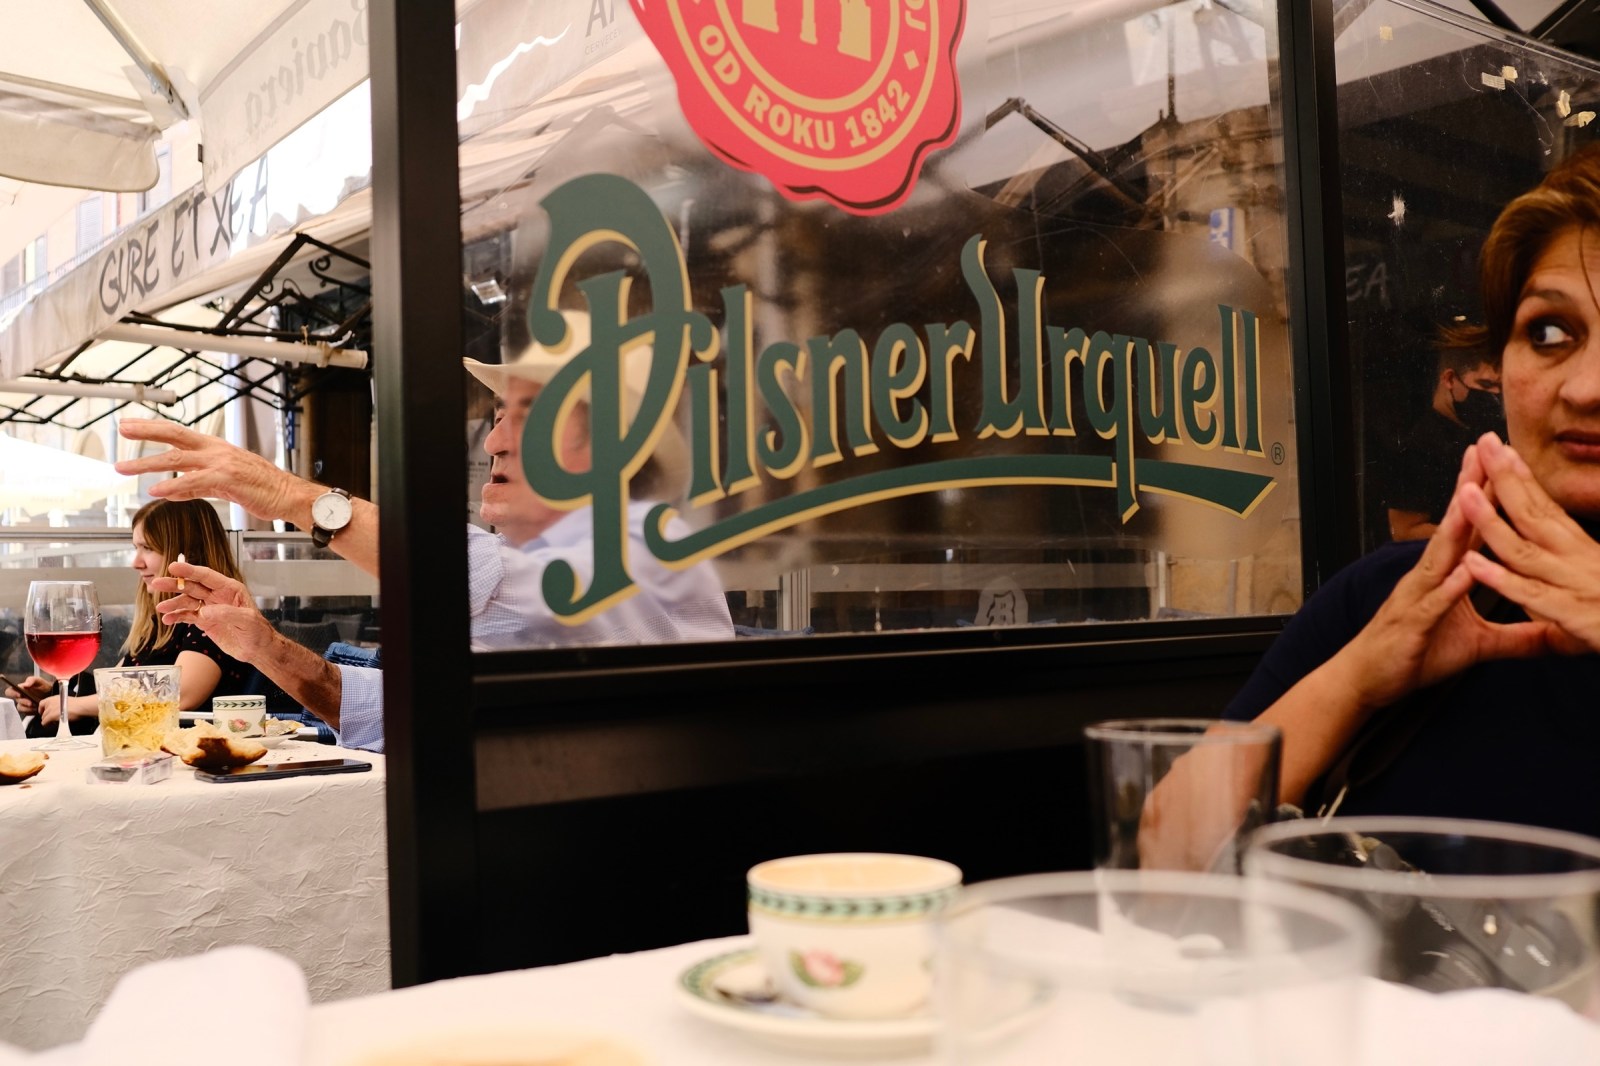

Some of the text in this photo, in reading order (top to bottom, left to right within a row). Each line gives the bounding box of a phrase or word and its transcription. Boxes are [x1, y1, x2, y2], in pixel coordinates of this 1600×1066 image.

[699, 24, 911, 151] OD ROKU 1842
[100, 219, 160, 315] GURE
[521, 173, 976, 626] Pilsner
[960, 232, 1266, 524] Urquell
